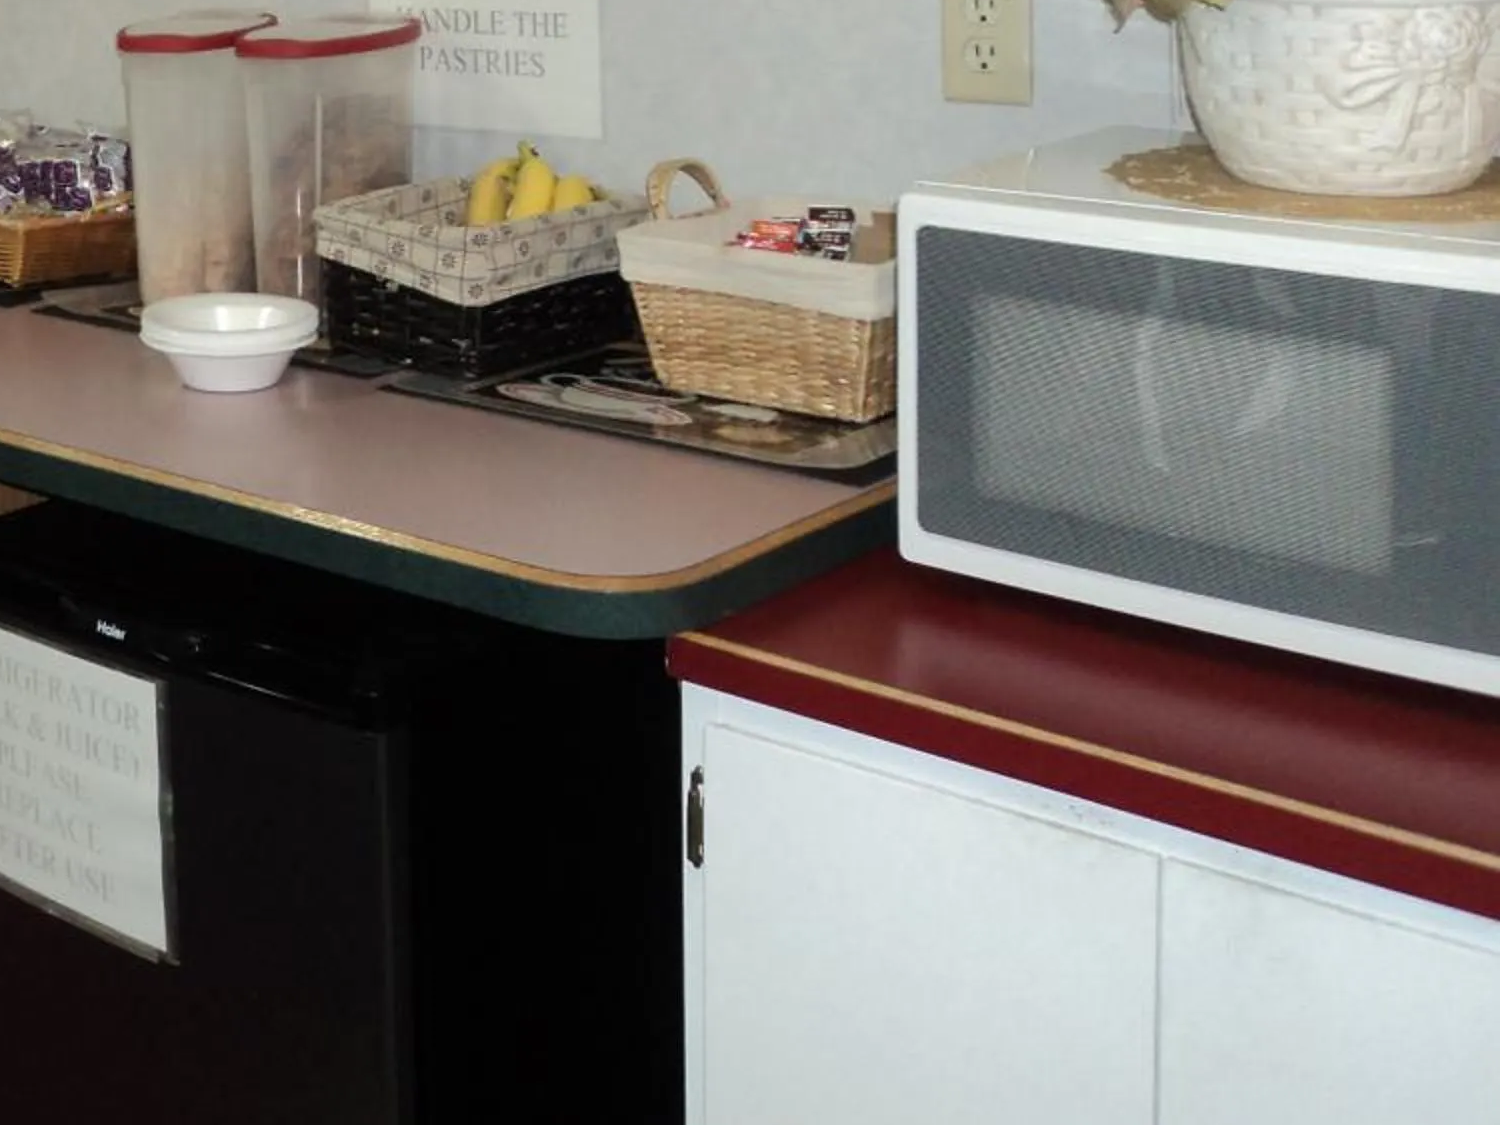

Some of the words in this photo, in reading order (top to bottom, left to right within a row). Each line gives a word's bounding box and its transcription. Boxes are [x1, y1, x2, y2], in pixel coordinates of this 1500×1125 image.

[396, 6, 506, 36] ANDLE
[512, 11, 570, 39] THE
[419, 46, 546, 77] PASTRIES
[26, 712, 46, 743] &
[65, 857, 116, 903] USE
